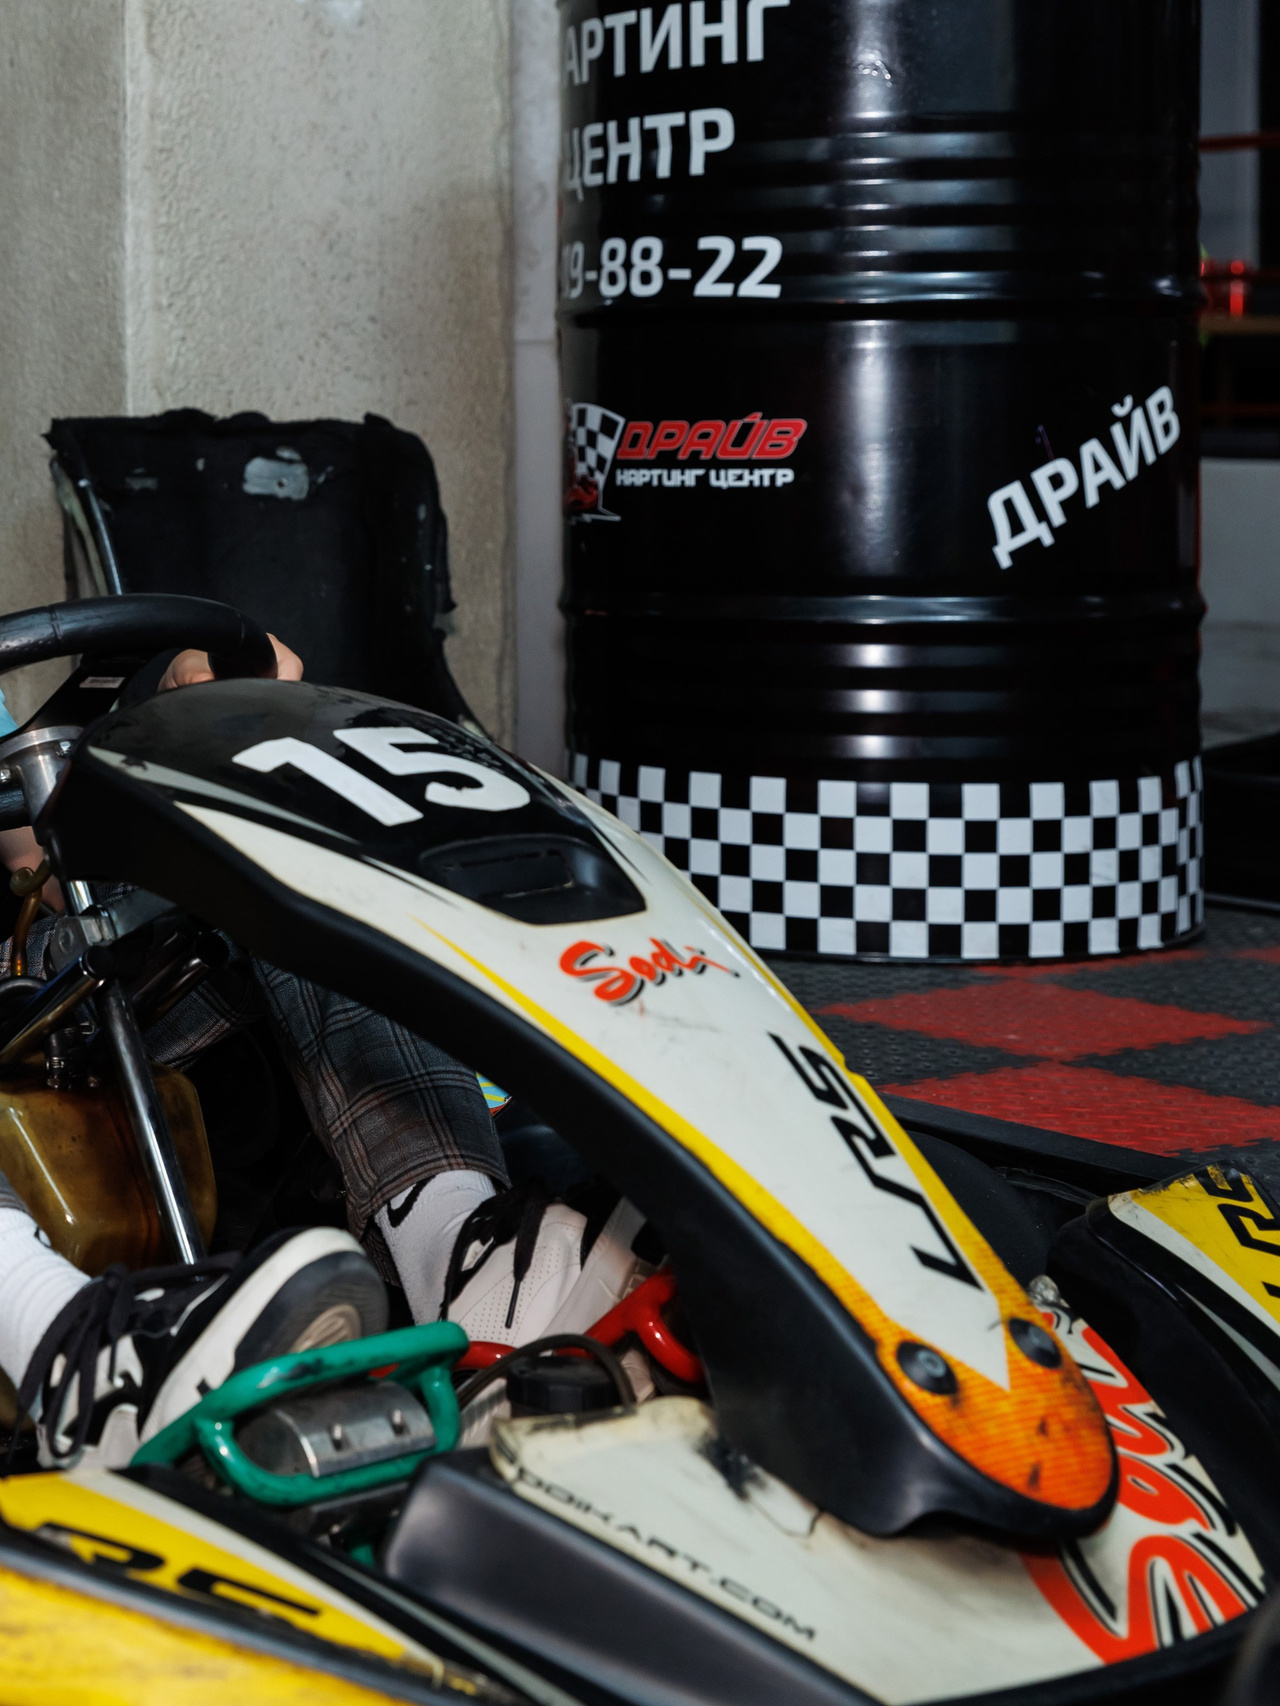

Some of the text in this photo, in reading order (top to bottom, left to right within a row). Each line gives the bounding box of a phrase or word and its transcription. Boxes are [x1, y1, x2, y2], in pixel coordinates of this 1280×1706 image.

[566, 107, 736, 202] ЦЕНТР
[616, 412, 808, 461] ДРАЙВ
[987, 385, 1180, 570] ДРАЙВ
[708, 468, 795, 490] ЦЕНТР
[231, 726, 531, 827] 15
[558, 937, 741, 1007] Sodi
